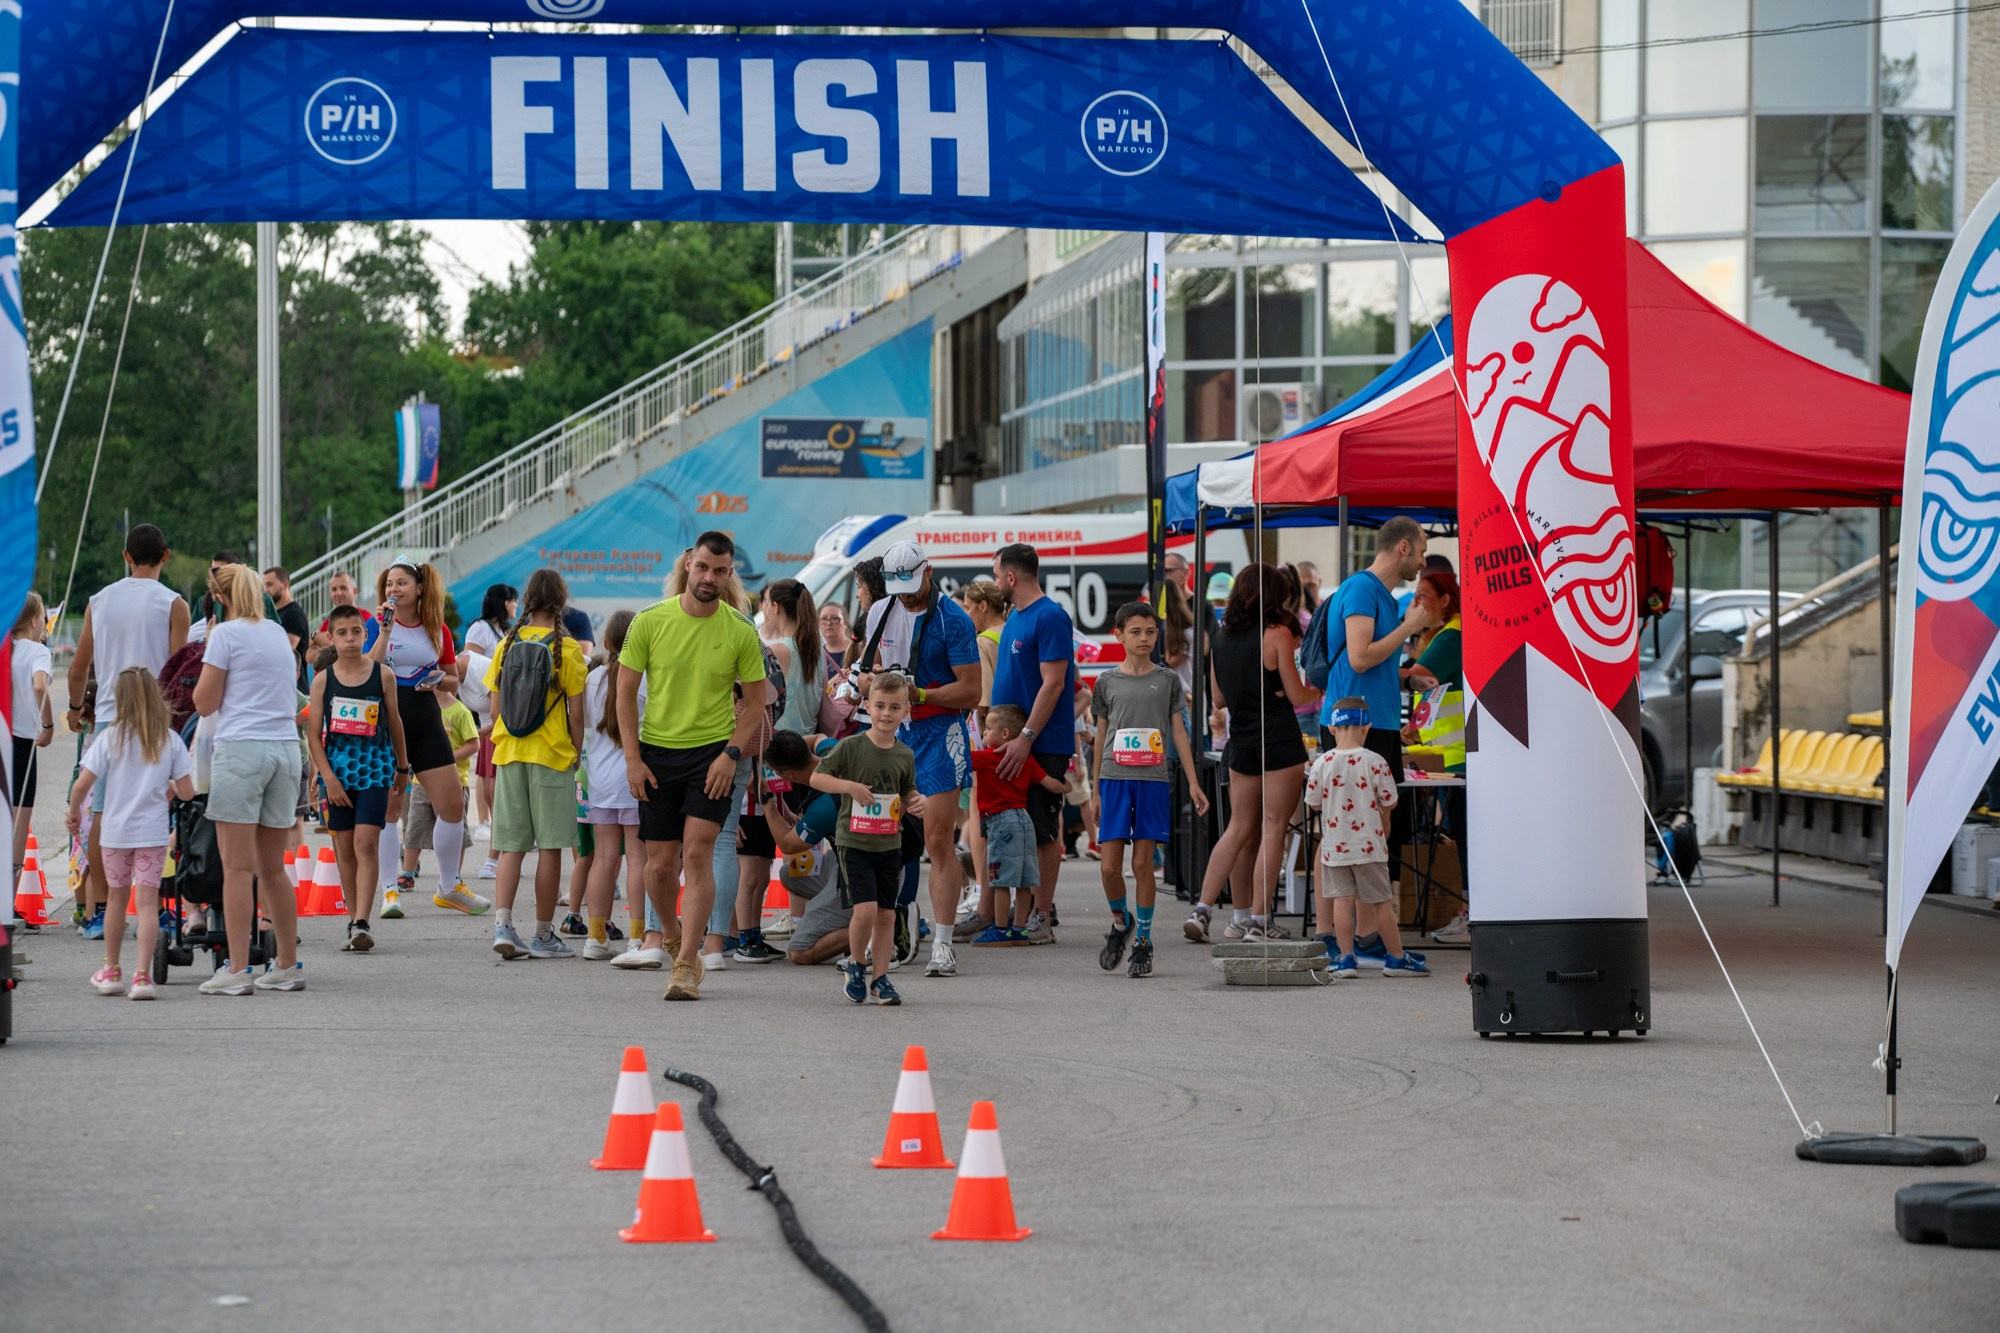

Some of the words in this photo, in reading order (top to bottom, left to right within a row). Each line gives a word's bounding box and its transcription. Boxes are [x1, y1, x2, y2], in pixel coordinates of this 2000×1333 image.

[321, 104, 380, 132] P/H
[1118, 108, 1129, 116] IN
[490, 56, 990, 197] FINISH
[1096, 117, 1152, 143] P/H
[321, 134, 380, 142] MARKOVO
[1098, 145, 1153, 154] MARKOVO
[0, 408, 19, 447] S
[765, 438, 829, 454] european
[797, 449, 845, 464] rowing
[777, 464, 841, 475] championships
[696, 491, 749, 513] 2025
[915, 532, 998, 544] ТРАНСПОРТ
[1018, 530, 1083, 542] ЛИНЕЙКА
[1473, 505, 1501, 529] HILLS
[1526, 509, 1566, 563] MARKOVO
[540, 548, 605, 561] European
[611, 548, 661, 563] Rowing
[1474, 541, 1539, 575] PLOVDIV
[1486, 567, 1532, 594] HILLS
[1505, 615, 1530, 628] RUN
[1966, 657, 2000, 746] EV
[339, 705, 358, 718] 64
[1123, 735, 1141, 749] 16
